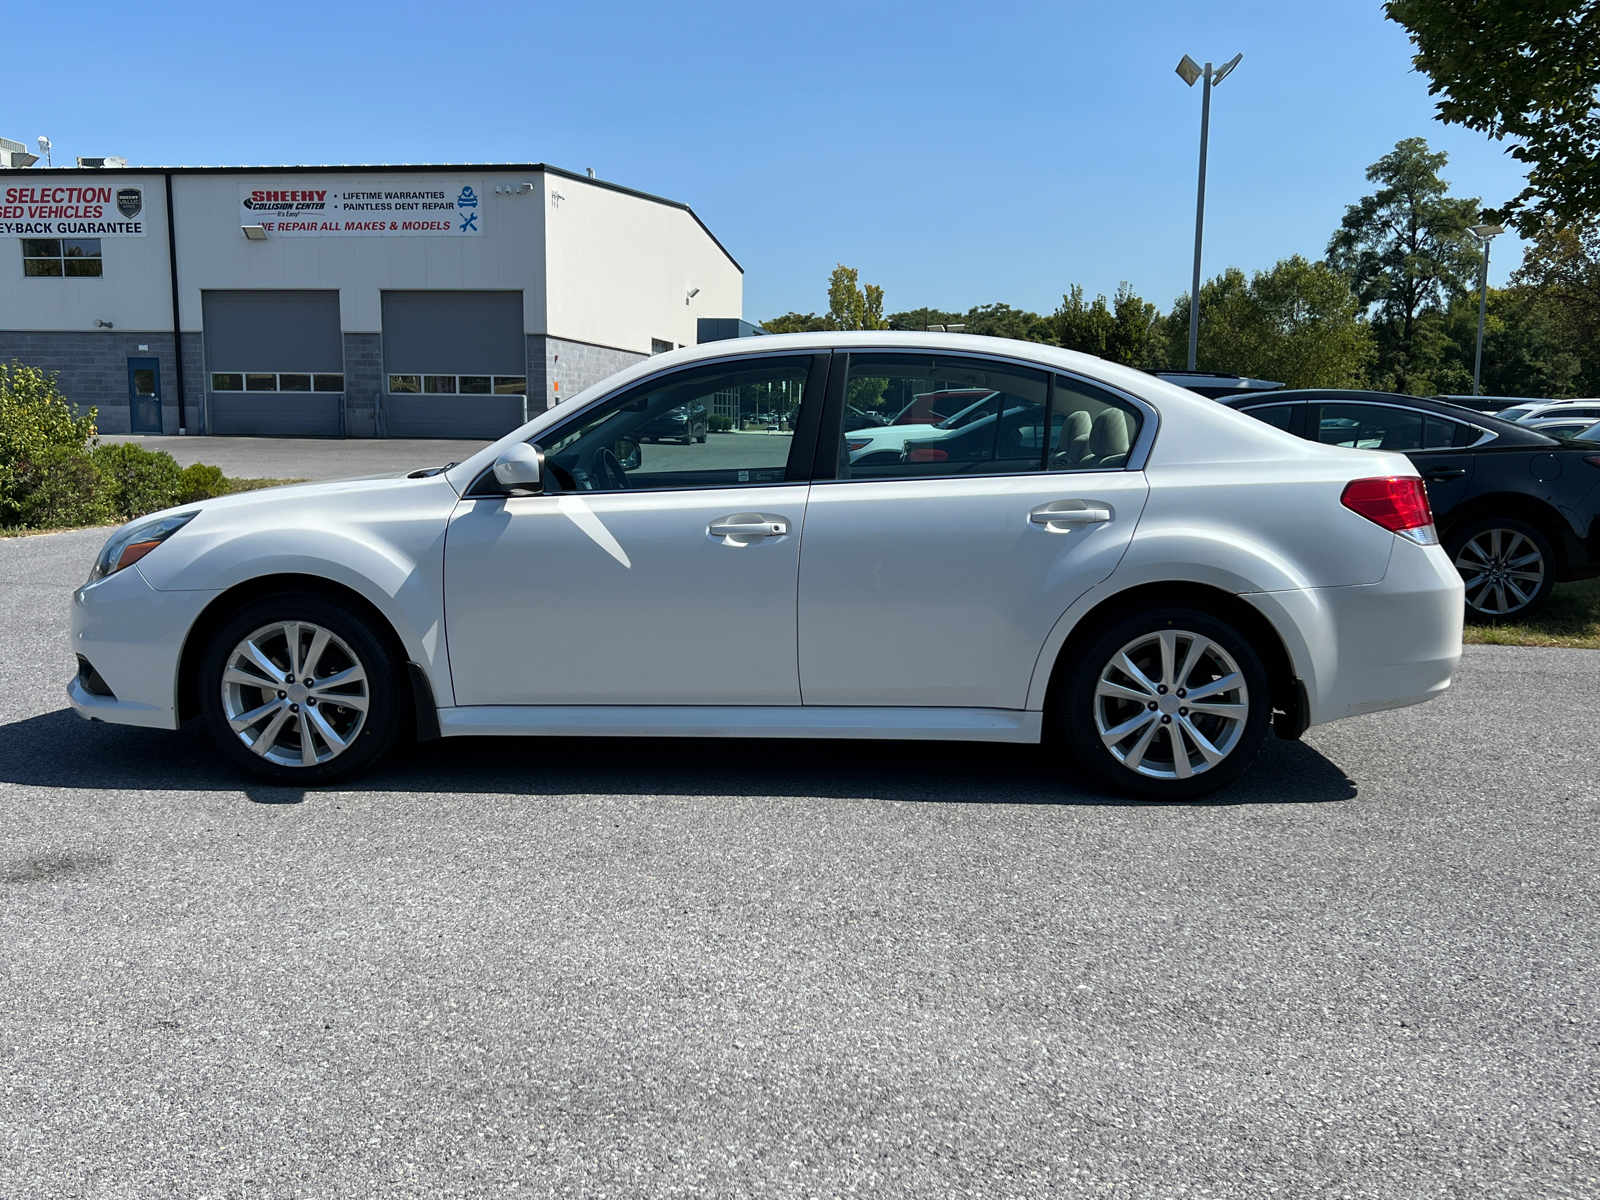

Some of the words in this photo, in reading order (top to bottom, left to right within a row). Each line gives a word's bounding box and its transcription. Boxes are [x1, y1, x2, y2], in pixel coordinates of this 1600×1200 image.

[6, 187, 111, 203] SELECTION
[252, 191, 327, 202] SHEEHY
[385, 192, 445, 200] WARRANTIES
[422, 202, 455, 210] REPAIR
[28, 206, 103, 218] VEHICLES
[57, 223, 142, 233] GUARANTEE
[278, 222, 318, 231] REPAIR
[320, 222, 341, 230] ALL
[344, 222, 386, 231] MAKES
[389, 222, 398, 230] &
[402, 221, 451, 230] MODELS
